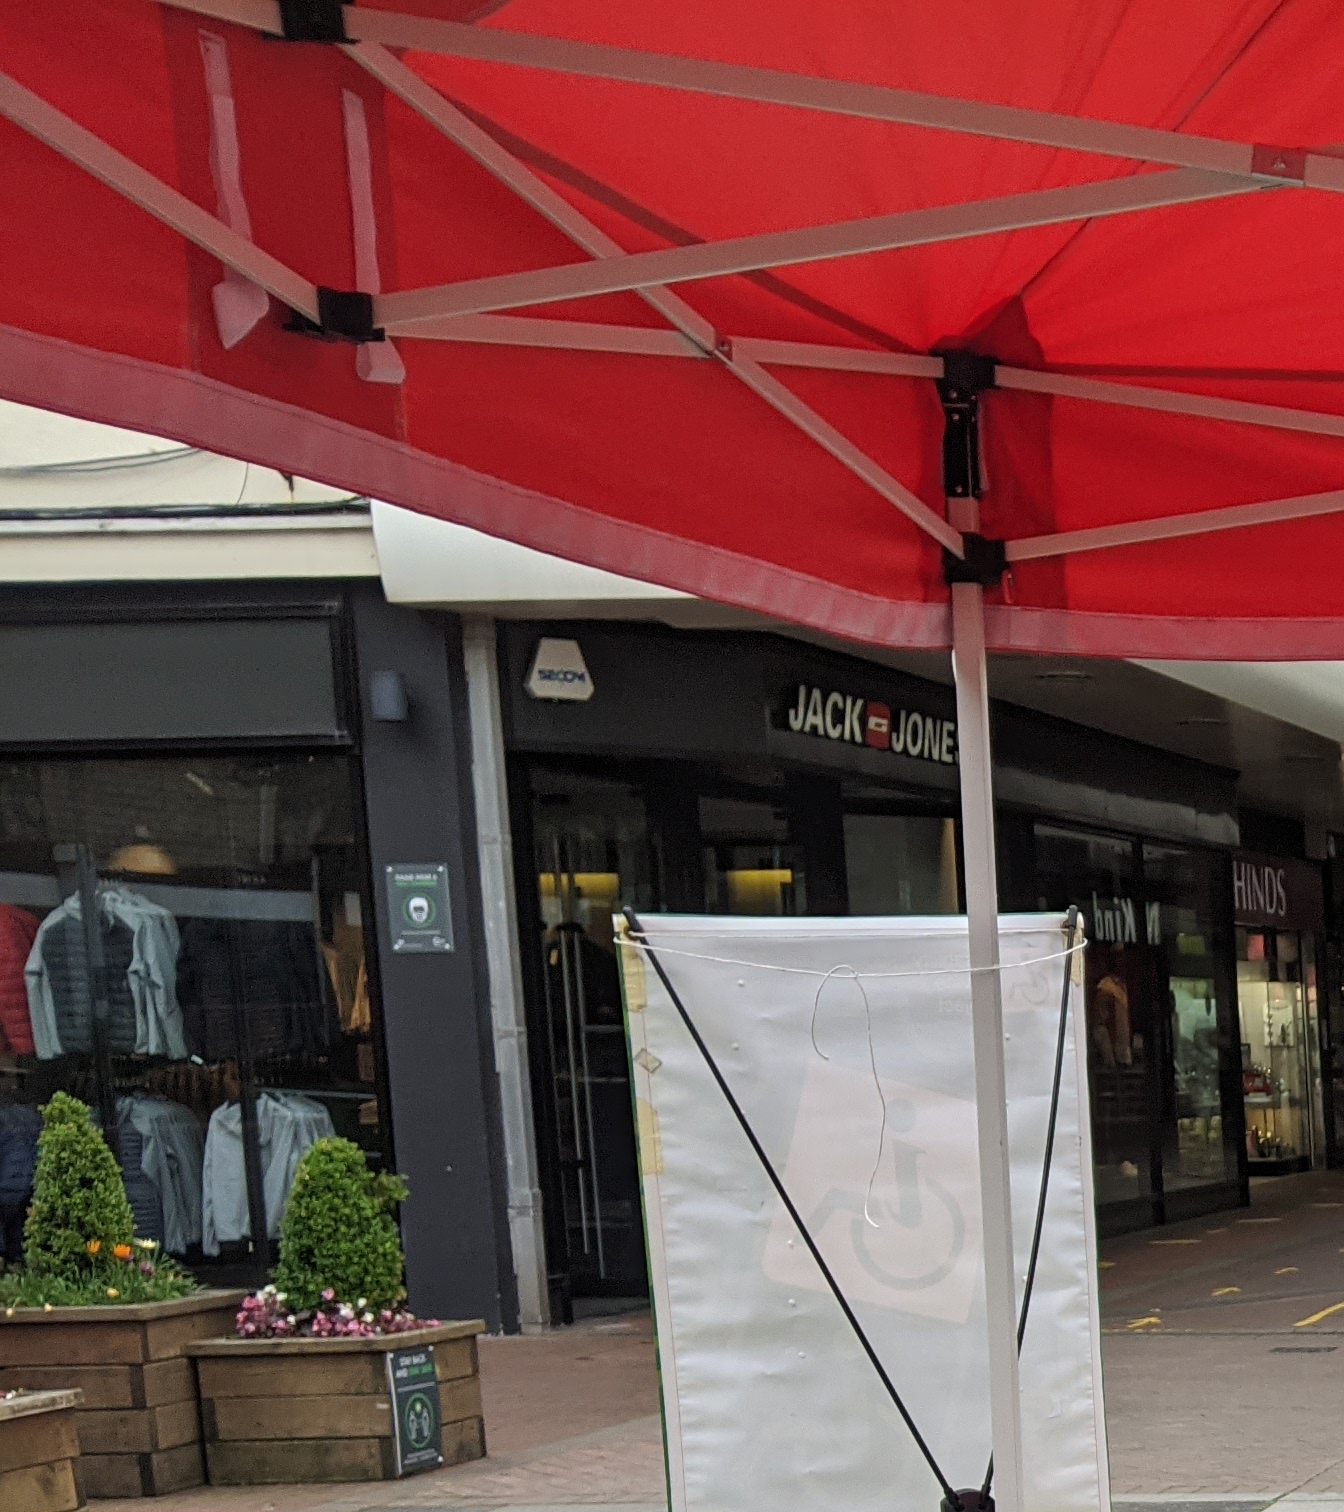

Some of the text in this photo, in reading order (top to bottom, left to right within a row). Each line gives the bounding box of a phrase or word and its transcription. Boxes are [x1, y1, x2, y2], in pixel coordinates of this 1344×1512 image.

[789, 685, 958, 764] JACK JONE
[1233, 861, 1286, 917] HINDS
